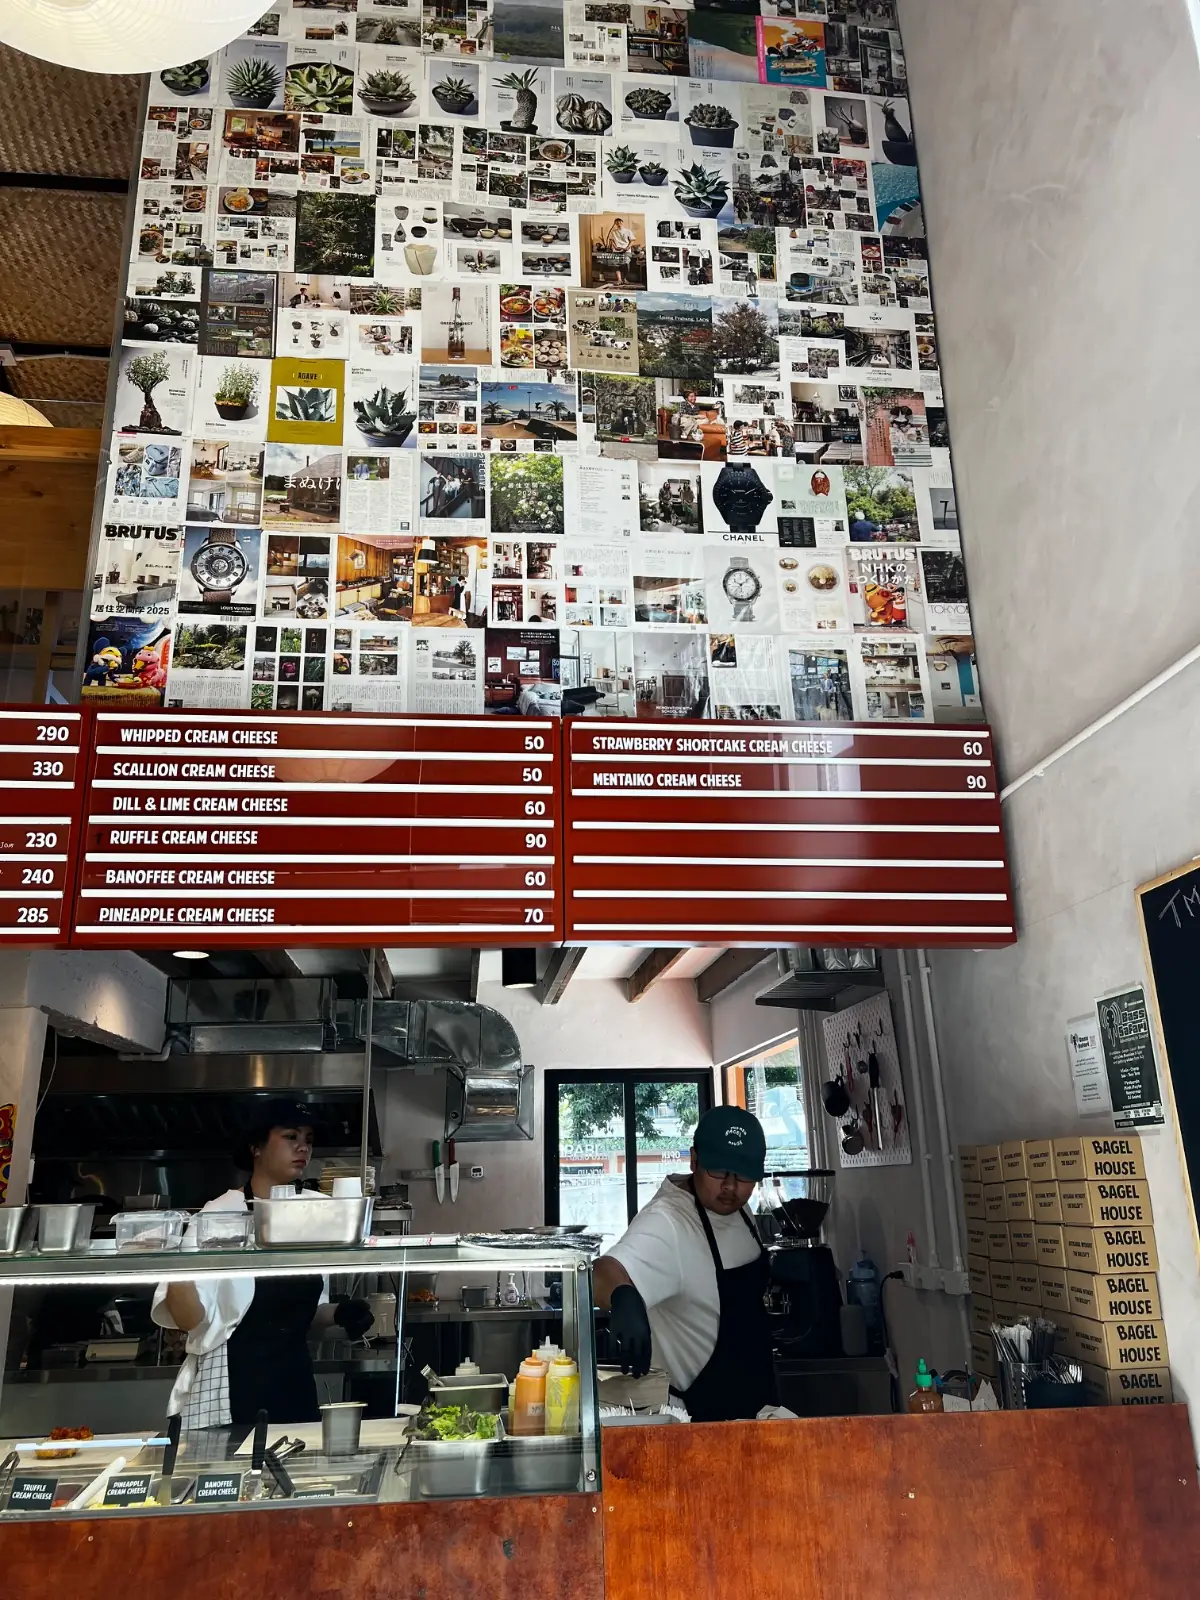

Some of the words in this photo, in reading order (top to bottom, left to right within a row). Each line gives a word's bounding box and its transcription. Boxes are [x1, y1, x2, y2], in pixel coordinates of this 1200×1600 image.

[297, 372, 318, 380] AGAVE
[104, 524, 179, 541] BRUTUS
[722, 534, 765, 542] CHANEL
[849, 548, 917, 561] BRUTUS
[861, 563, 907, 574] NHKの
[856, 574, 916, 585] つくりかた
[146, 606, 170, 615] 2025
[37, 726, 69, 741] 290
[120, 729, 182, 744] WHIPPED
[184, 730, 228, 744] CREAM
[232, 731, 278, 745] CHEESE
[524, 736, 545, 750] 50
[592, 736, 673, 752] STRAWBERRY
[676, 738, 747, 752] SHORTCAKE
[749, 739, 789, 753] CREAM
[791, 739, 833, 754] CHEESE
[963, 742, 983, 756] 60
[32, 761, 64, 776] 330
[113, 763, 179, 777] SCALLION
[181, 764, 226, 778] CREAM
[228, 765, 276, 779] CHEESE
[522, 767, 543, 782] 50
[592, 773, 654, 787] MENTAIKO
[656, 774, 697, 787] CREAM
[699, 774, 742, 788] CHEESE
[966, 775, 987, 789] 90
[113, 797, 141, 811] DILL
[144, 797, 157, 811] &
[160, 797, 190, 811] LIME
[194, 798, 238, 811] CREAM
[242, 798, 288, 812] CHEESE
[524, 801, 546, 816] 60
[26, 833, 57, 848] 230
[110, 830, 158, 844] RUFFLE
[162, 831, 207, 844] CREAM
[211, 831, 258, 845] CHEESE
[525, 834, 547, 849] 90
[22, 869, 54, 884] 240
[106, 870, 175, 884] BANOFFEE
[179, 870, 224, 884] CREAM
[228, 870, 275, 885] CHEESE
[524, 871, 546, 886] 60
[17, 908, 48, 923] 285
[99, 908, 174, 922] PINEAPPLE
[177, 908, 223, 922] CREAM
[227, 908, 275, 923] CHEESE
[524, 908, 544, 923] 70
[1121, 1008, 1146, 1024] Bass
[1118, 1019, 1148, 1038] Safari
[1092, 1140, 1133, 1155] BAGEL
[1094, 1161, 1136, 1176] HOUSE
[1097, 1184, 1140, 1199] BAGEL
[1100, 1206, 1143, 1221] HOUSE
[1104, 1230, 1146, 1246] BAGEL
[1106, 1252, 1150, 1268] HOUSE
[1106, 1278, 1149, 1294] BAGEL
[1109, 1300, 1153, 1316] HOUSE
[1116, 1325, 1158, 1341] BAGEL
[1119, 1347, 1161, 1363] HOUSE
[1119, 1374, 1163, 1390] BAGEL
[23, 1484, 46, 1492] TRUFFLE
[113, 1480, 145, 1488] PINEAPPLE
[198, 1488, 216, 1496] CREAM
[217, 1487, 238, 1496] CHEESE
[204, 1480, 233, 1488] BANOFFEE
[12, 1491, 32, 1499] CREAM
[32, 1492, 53, 1500] CHEESE
[107, 1488, 126, 1496] CREAM
